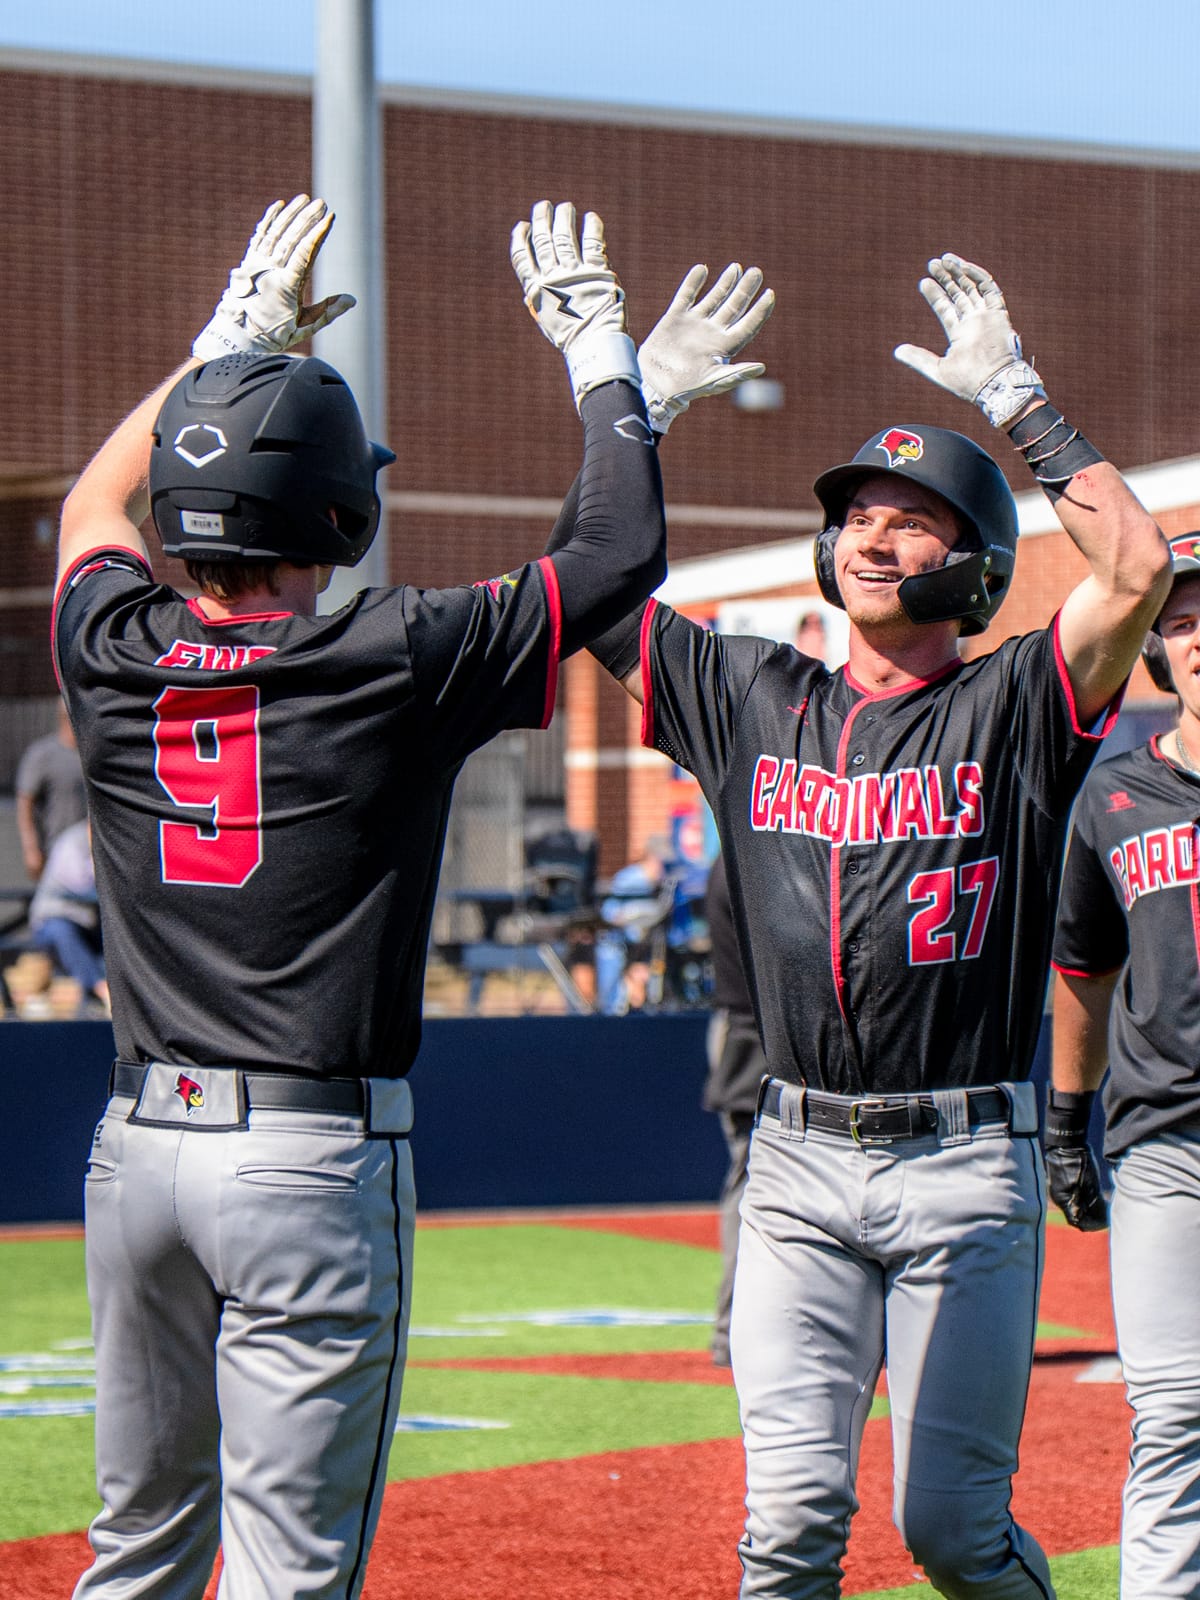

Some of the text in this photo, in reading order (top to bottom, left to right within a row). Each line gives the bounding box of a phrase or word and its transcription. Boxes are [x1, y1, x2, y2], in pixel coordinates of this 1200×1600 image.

[152, 684, 263, 888] 9
[751, 754, 984, 848] CARDINALS
[907, 855, 1000, 966] 27
